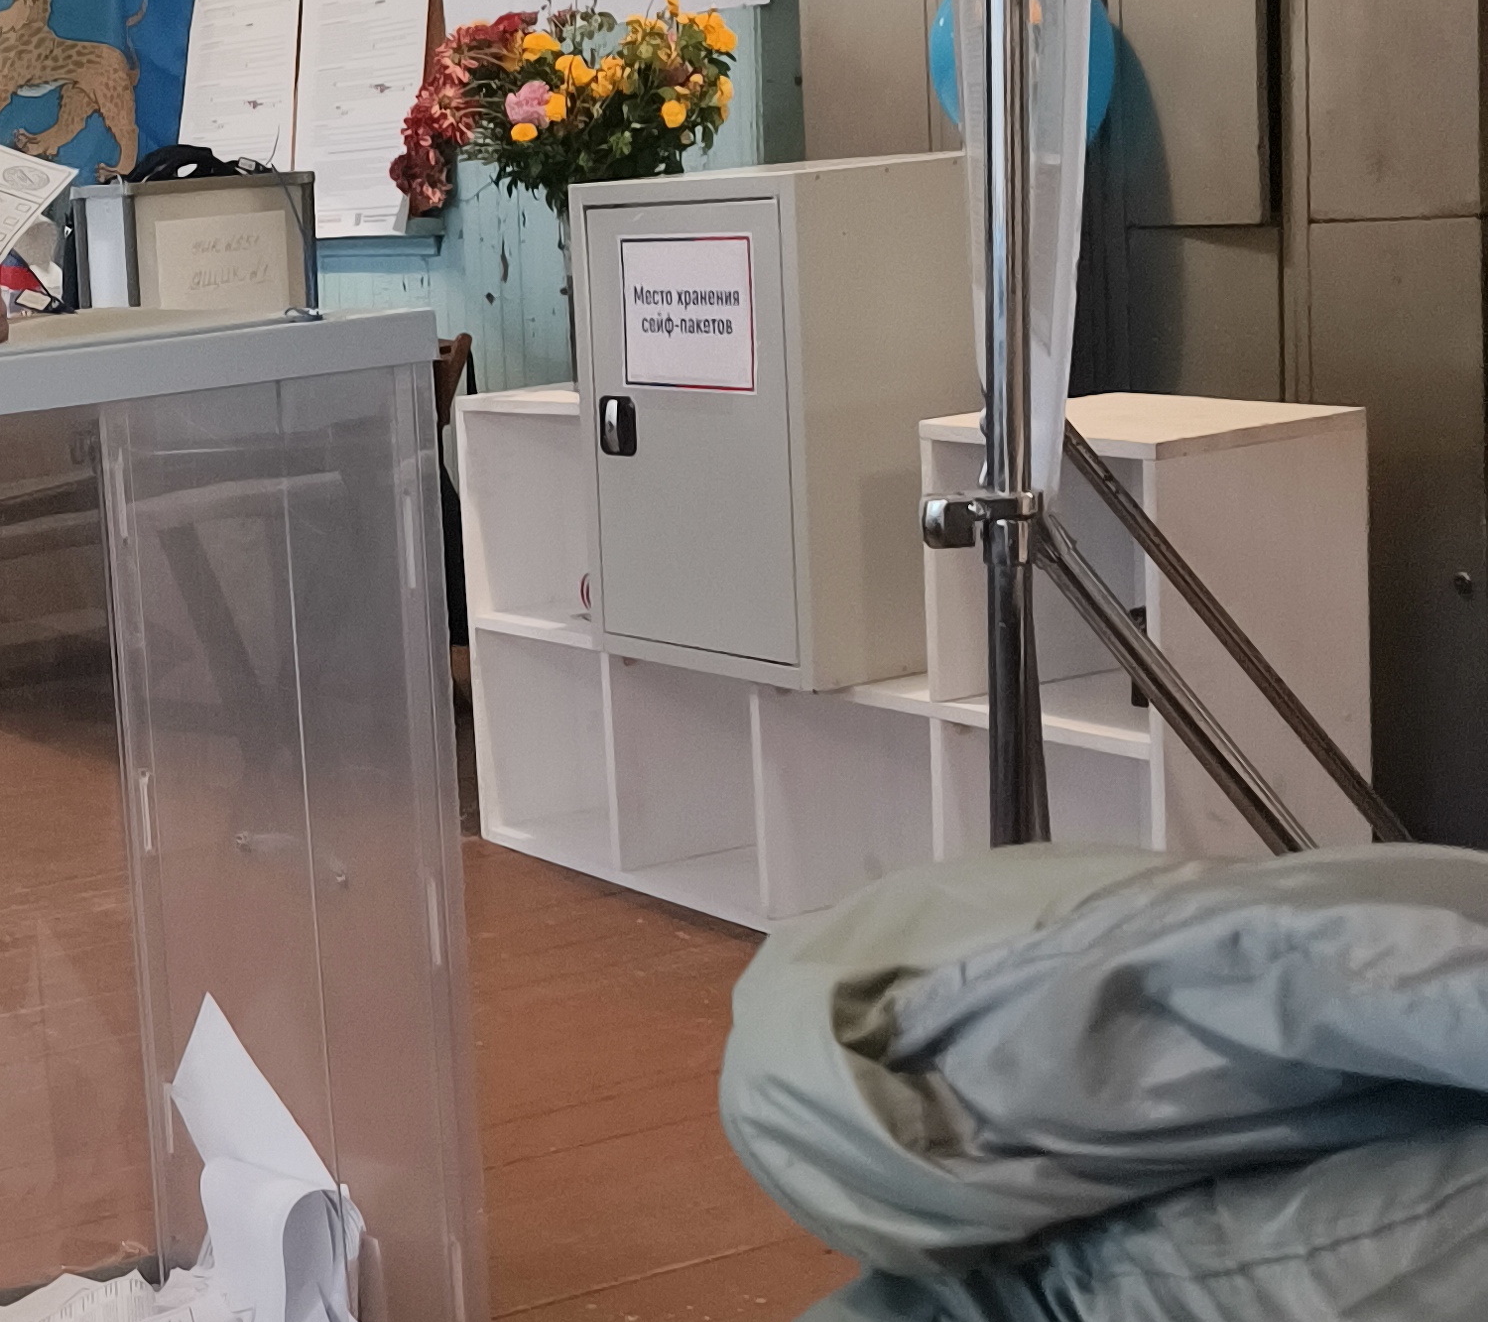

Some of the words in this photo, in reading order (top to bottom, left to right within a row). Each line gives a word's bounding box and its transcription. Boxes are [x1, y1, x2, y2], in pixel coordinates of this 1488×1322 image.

[633, 285, 673, 306] Место
[676, 288, 740, 311] хранения
[641, 312, 734, 338] сейф-пакетов
